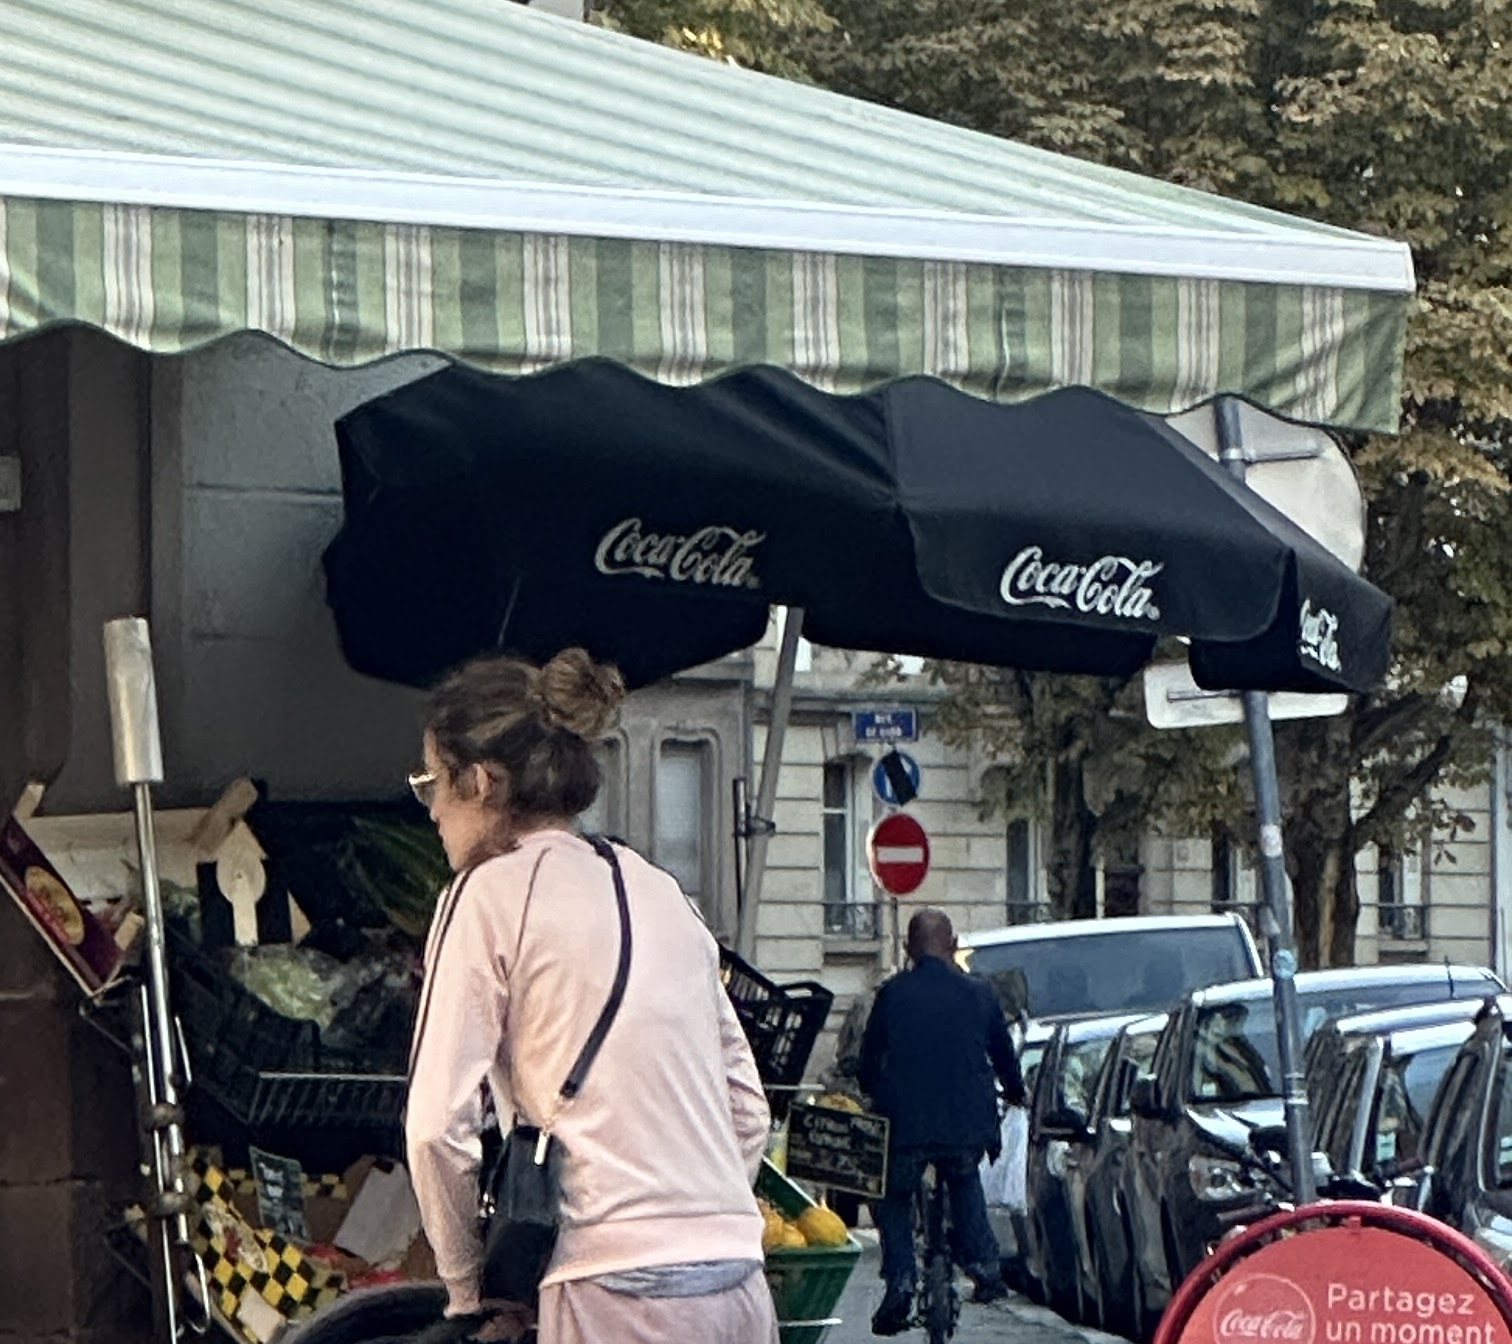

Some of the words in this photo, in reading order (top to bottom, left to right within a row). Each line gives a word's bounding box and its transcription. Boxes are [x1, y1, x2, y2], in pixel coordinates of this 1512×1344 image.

[594, 516, 762, 589] Coca-Cola
[999, 544, 1163, 620] Coca-Cola
[1327, 1283, 1476, 1317] Partagez
[1220, 1307, 1306, 1341] Coca-Cola
[1325, 1321, 1362, 1343] un
